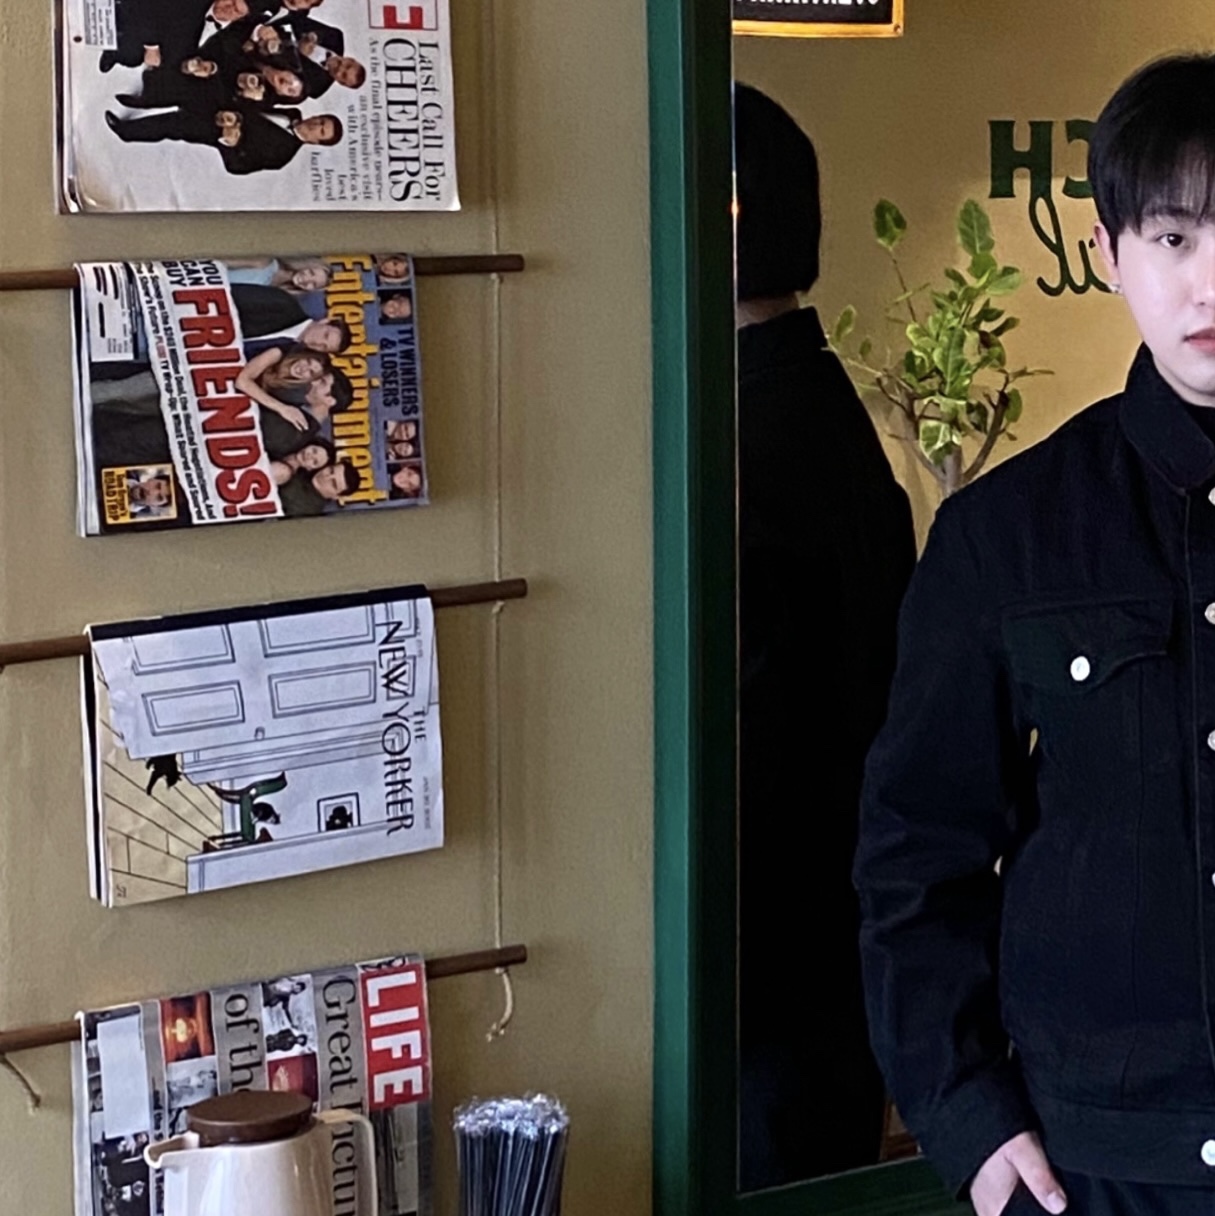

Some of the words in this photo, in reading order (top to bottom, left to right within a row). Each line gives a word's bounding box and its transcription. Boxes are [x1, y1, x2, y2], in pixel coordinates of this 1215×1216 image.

[369, 57, 380, 77] the
[418, 41, 439, 94] Last
[371, 80, 382, 110] final
[347, 104, 359, 134] with
[370, 112, 384, 157] episode
[382, 38, 424, 202] CHEERS
[421, 102, 443, 149] Call
[360, 114, 371, 171] exclusive
[310, 151, 323, 202] barflies
[324, 168, 336, 201] loved
[337, 173, 347, 201] best
[362, 174, 373, 201] visit
[425, 161, 446, 201] For
[162, 261, 187, 288] BUY
[180, 260, 206, 287] CAN
[199, 259, 223, 286] YOU
[379, 338, 397, 351] &
[397, 327, 415, 345] TV
[380, 352, 400, 408] LOSERS
[399, 346, 419, 417] WINNERS
[172, 287, 279, 519] FRIENDS!
[374, 620, 410, 698] NEW
[412, 705, 427, 742] THE
[381, 702, 415, 837] YORKER
[223, 992, 260, 1033] of
[322, 974, 360, 1094] Great
[366, 970, 424, 1104] LIFE
[228, 1043, 265, 1094] th
